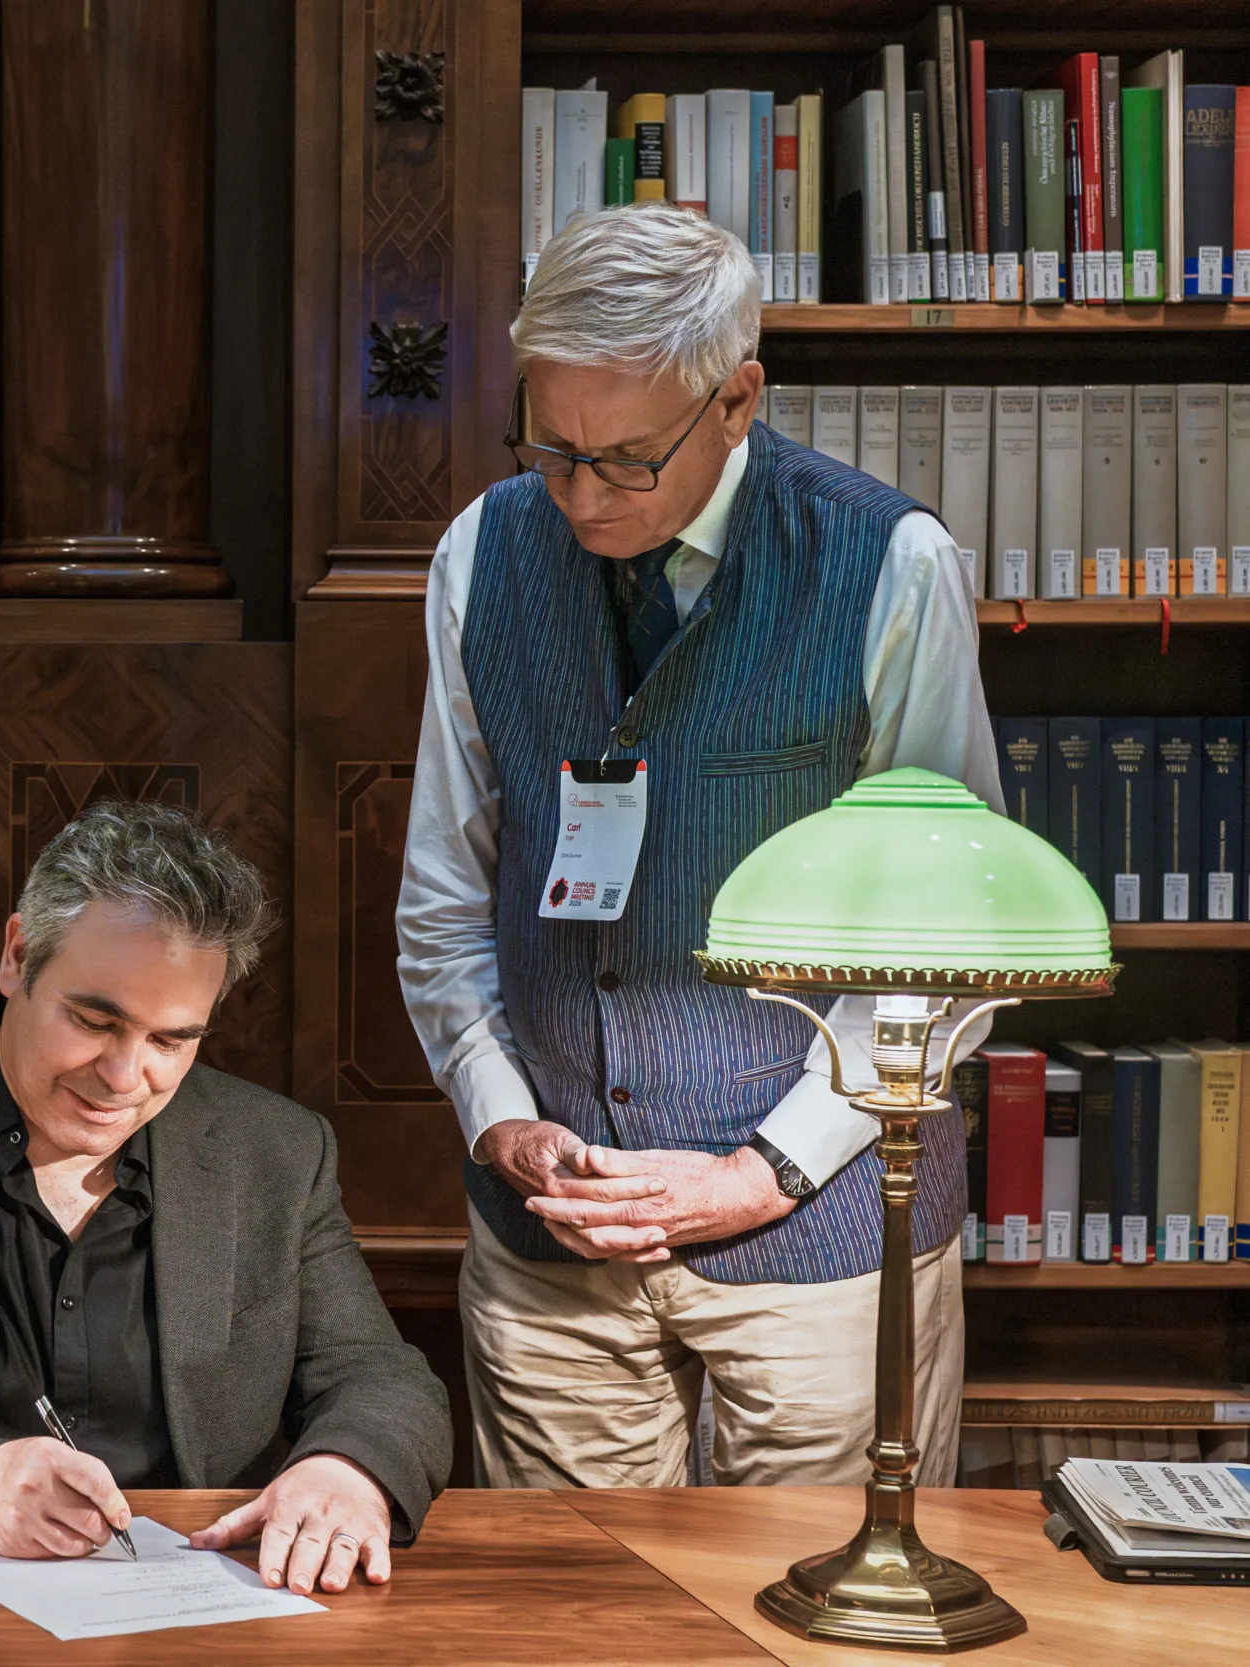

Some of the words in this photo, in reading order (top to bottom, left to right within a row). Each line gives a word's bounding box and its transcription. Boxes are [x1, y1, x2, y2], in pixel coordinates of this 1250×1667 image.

[926, 309, 942, 325] 17
[567, 823, 581, 832] Carl
[1114, 1465, 1157, 1497] COURIER
[1157, 1466, 1192, 1496] welcomes
[1180, 1474, 1213, 1500] council
[1206, 1497, 1225, 1509] our
